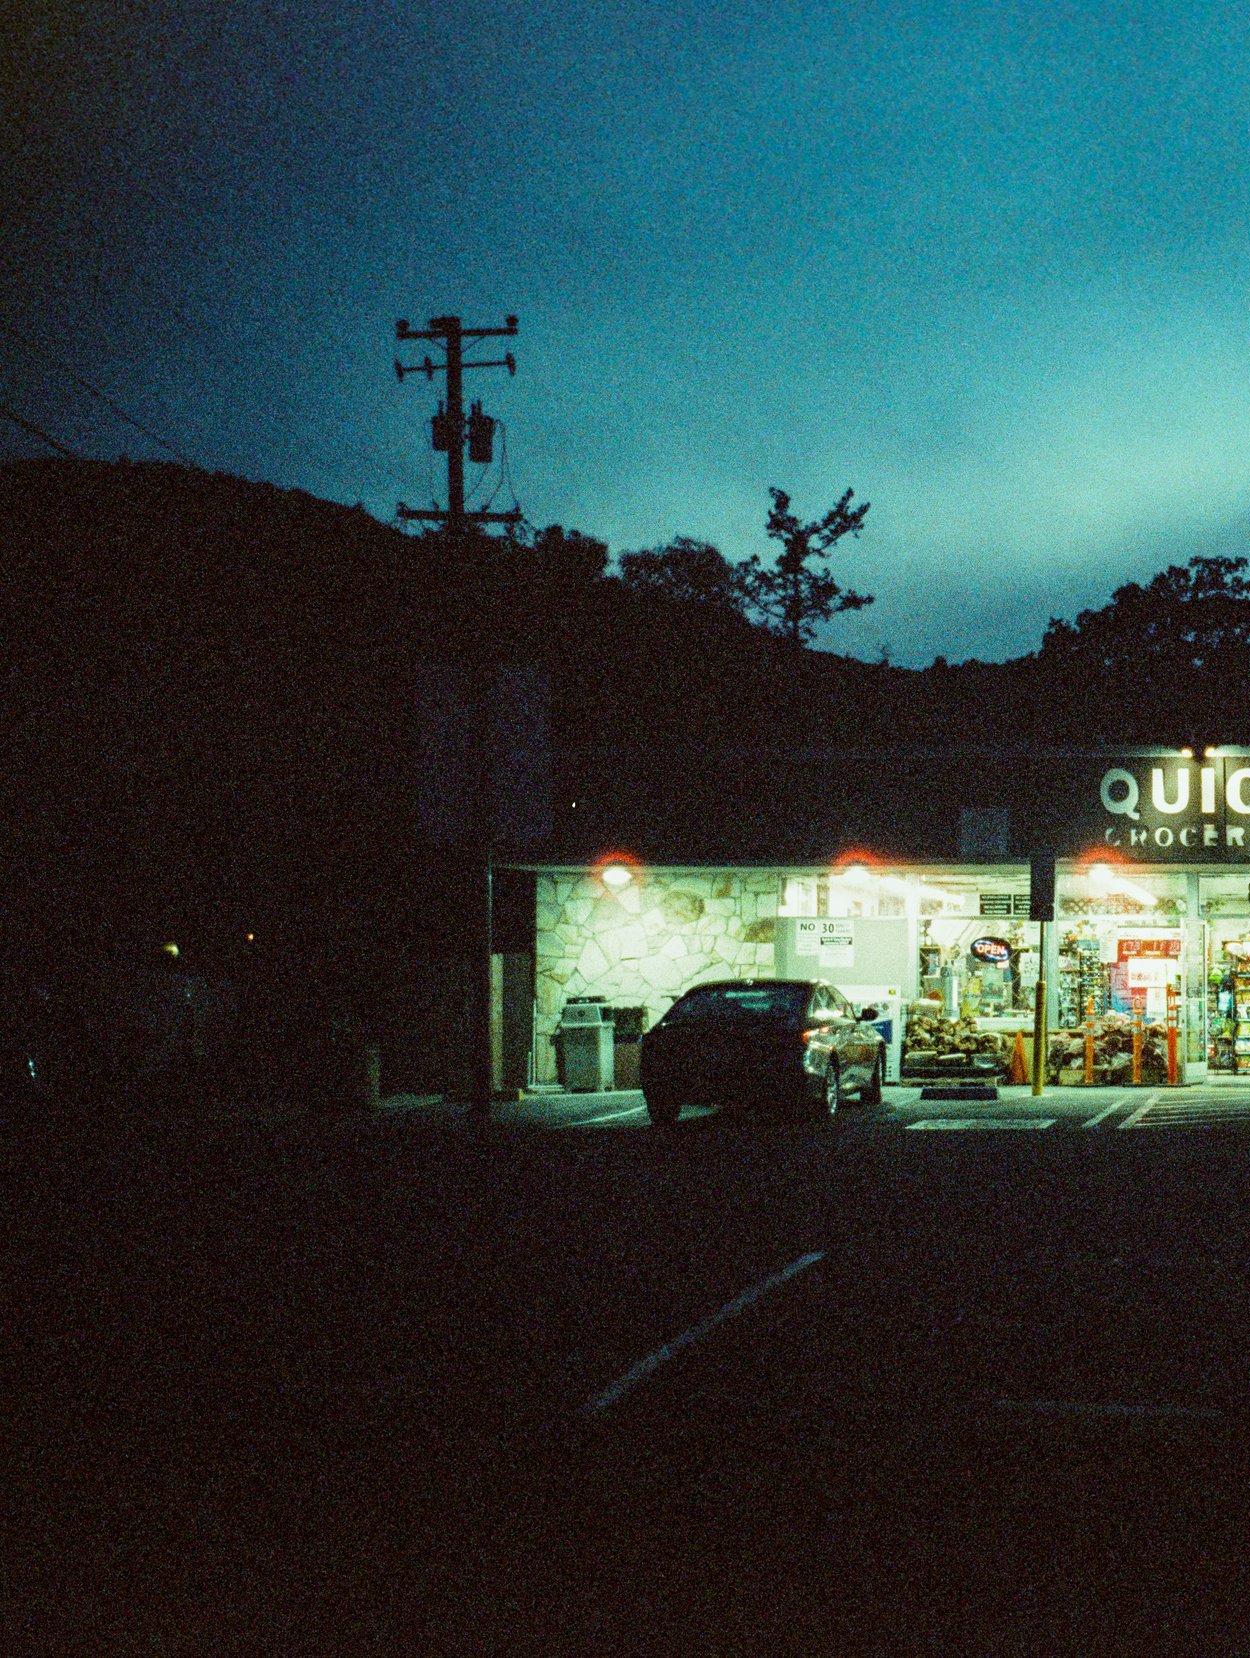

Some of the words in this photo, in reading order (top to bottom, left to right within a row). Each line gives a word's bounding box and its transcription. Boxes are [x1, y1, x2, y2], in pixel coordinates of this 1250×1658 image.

[800, 922, 816, 932] NO
[821, 923, 835, 934] 30
[977, 943, 1006, 955] OPEN
